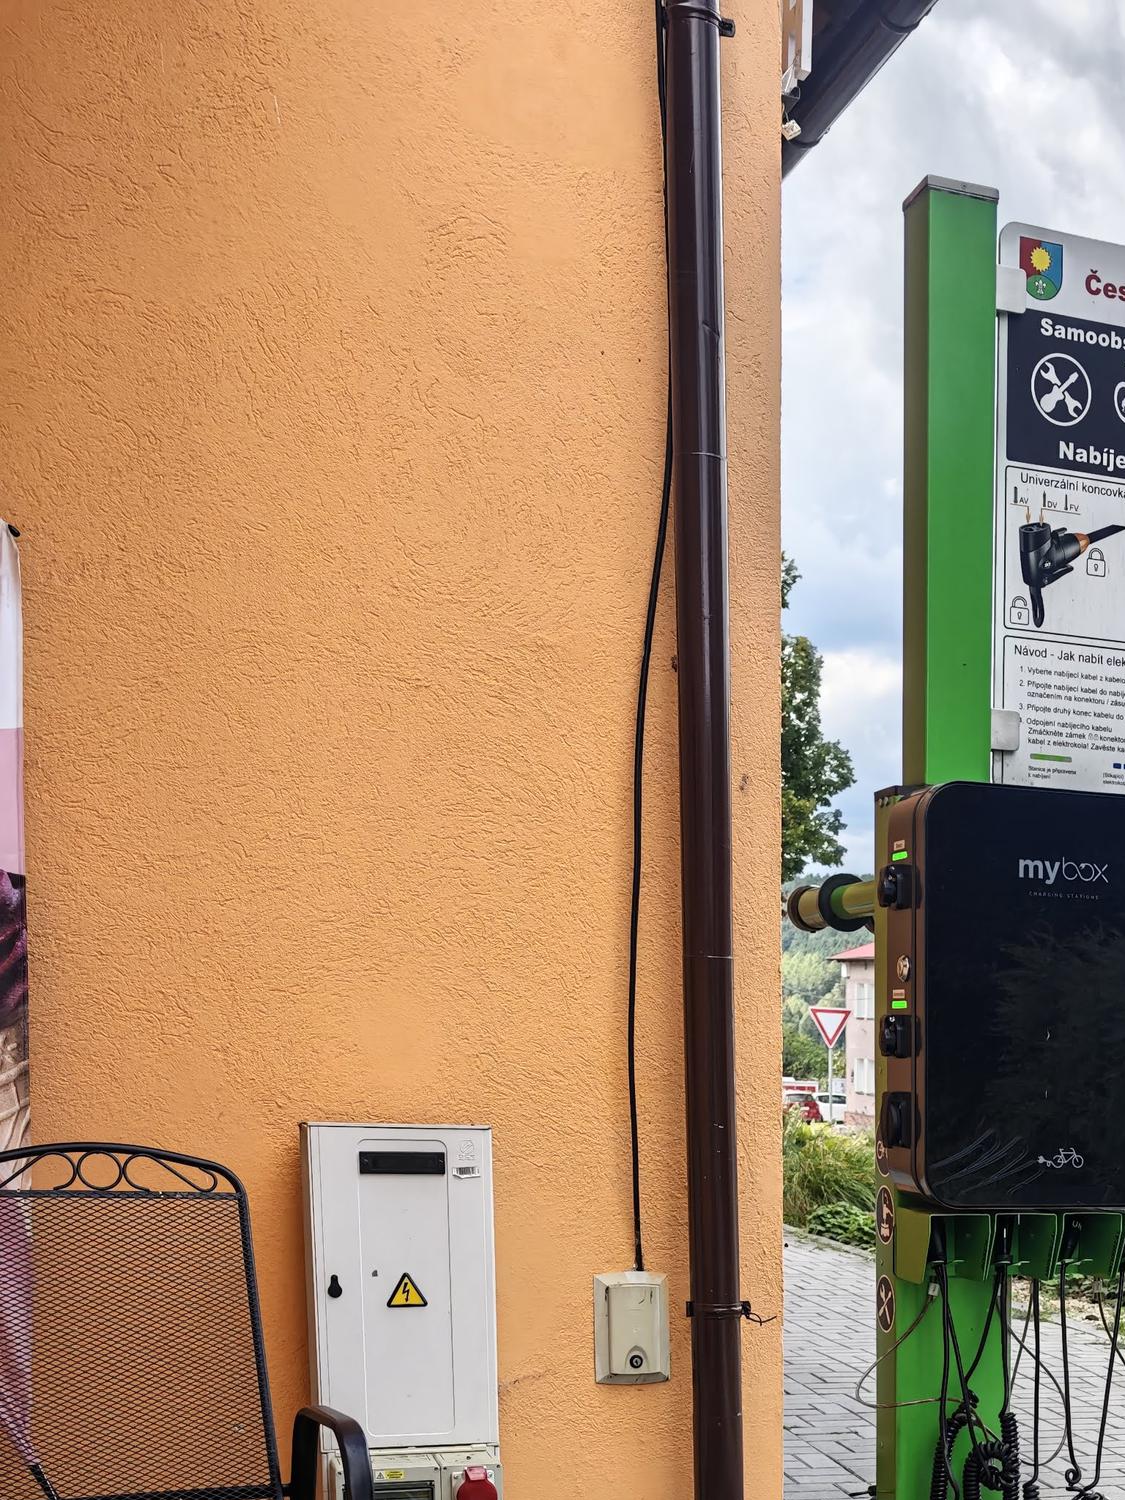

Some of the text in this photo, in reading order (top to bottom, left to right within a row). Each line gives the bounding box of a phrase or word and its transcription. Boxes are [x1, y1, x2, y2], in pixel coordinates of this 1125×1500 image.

[1020, 472, 1079, 491] Univerzální
[1014, 644, 1048, 659] Návod
[1057, 650, 1075, 662] Jak
[1078, 653, 1104, 665] nabít
[1052, 740, 1089, 749] elektrokola!
[1090, 743, 1116, 752] Zavěste
[1018, 856, 1109, 885] mybox
